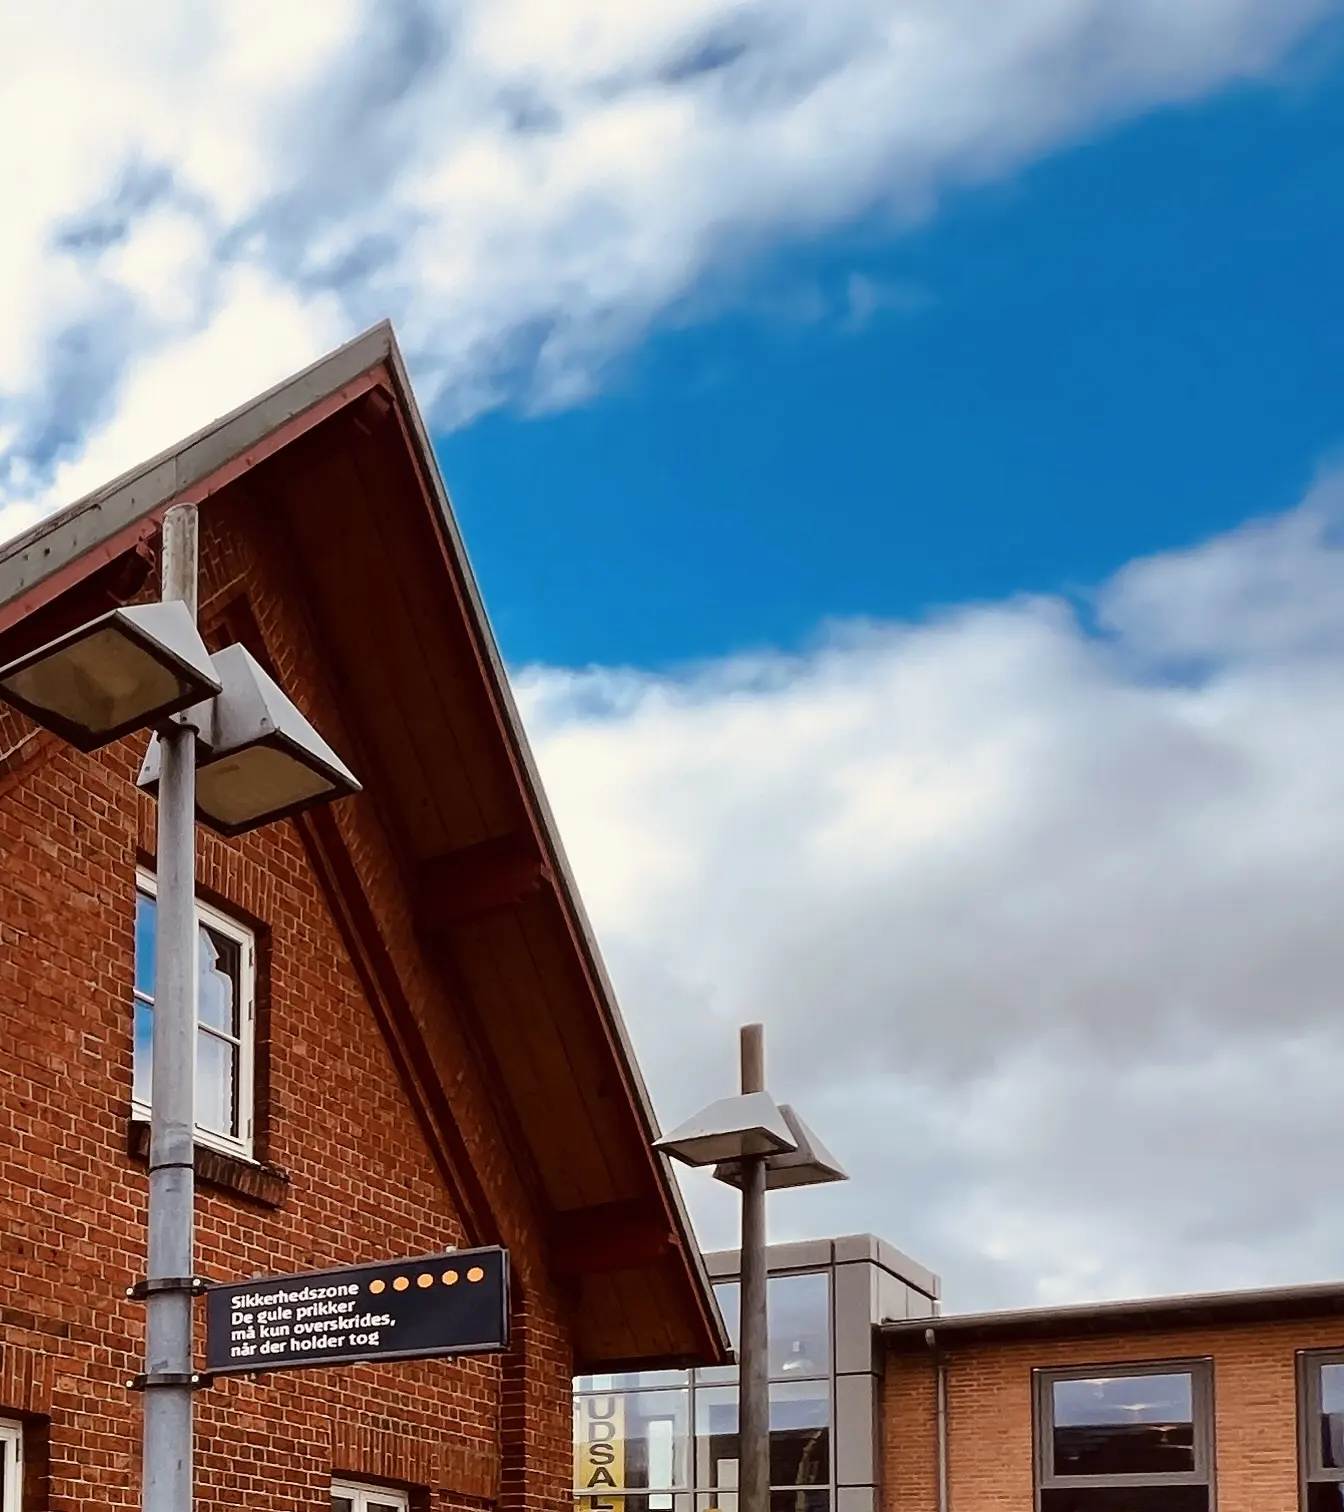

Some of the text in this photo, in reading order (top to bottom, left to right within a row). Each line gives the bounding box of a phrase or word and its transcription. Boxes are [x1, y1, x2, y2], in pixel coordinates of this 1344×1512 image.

[230, 1283, 359, 1310] Sikkerhedszone
[230, 1312, 396, 1341] må kun overskrides,
[231, 1299, 356, 1326] De gule prikker
[230, 1329, 380, 1358] når der holder tog
